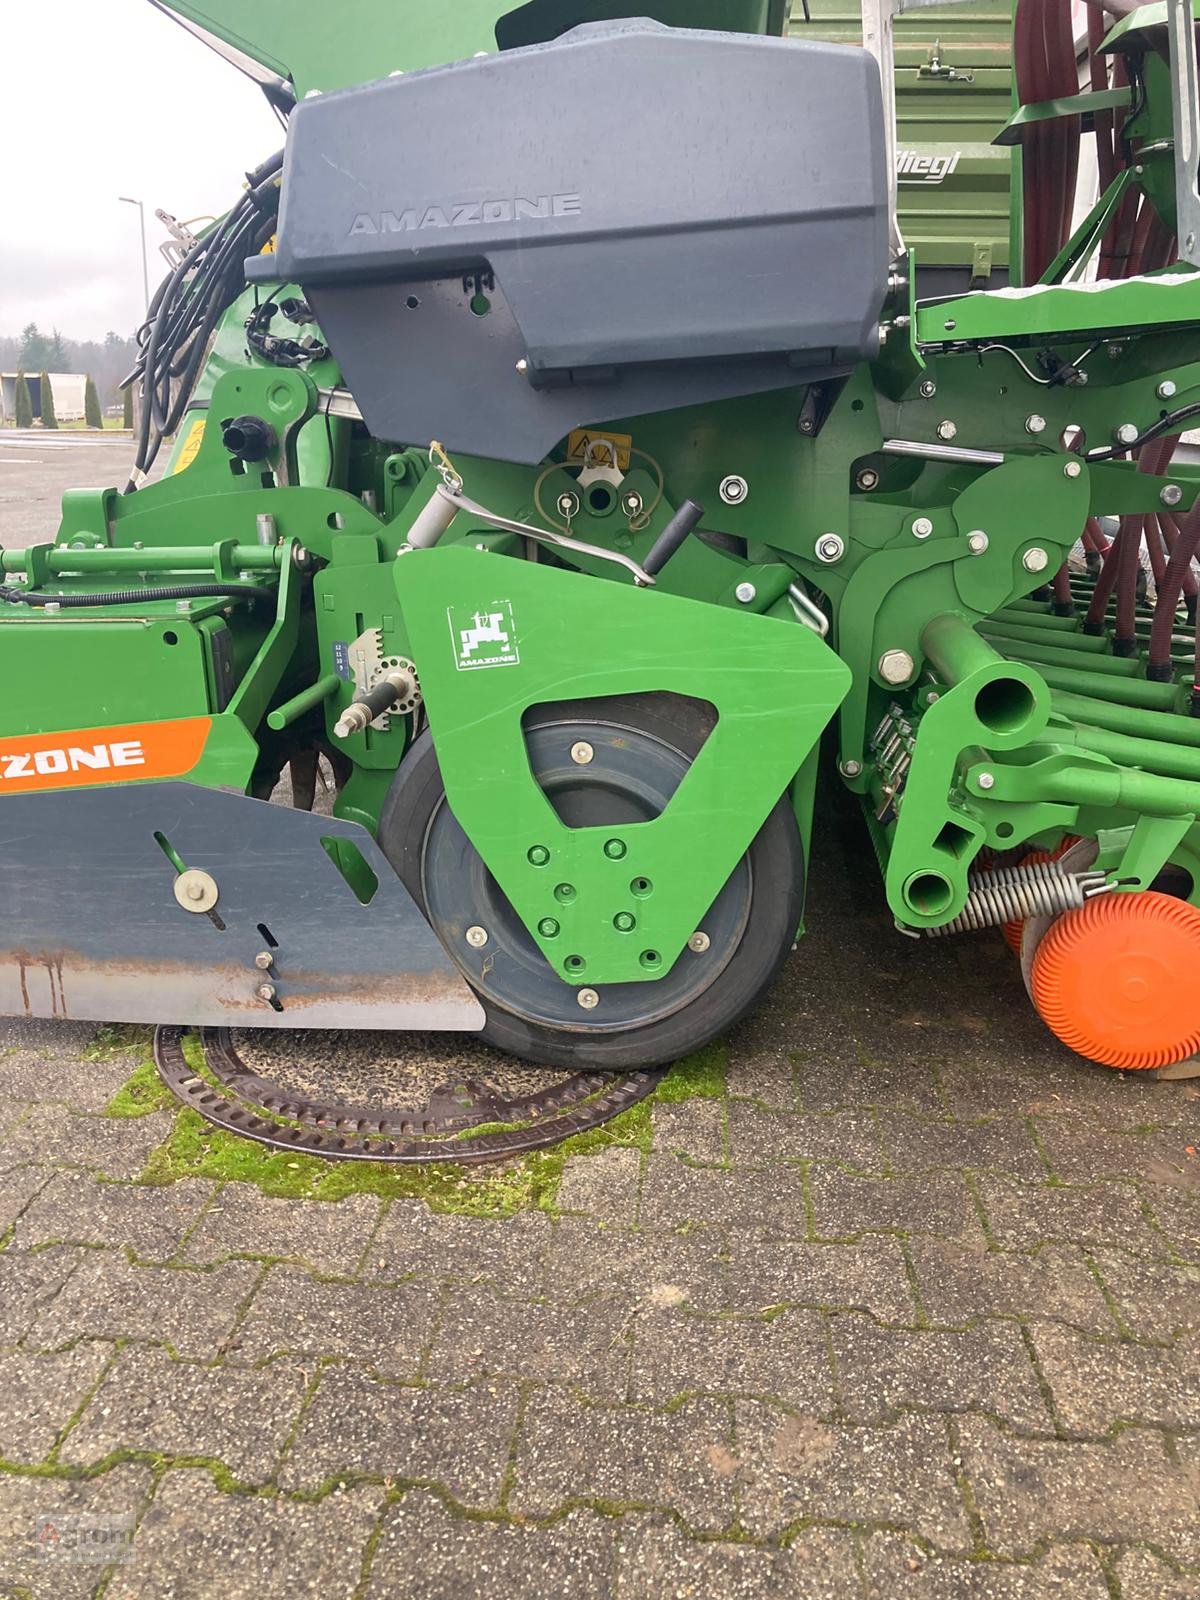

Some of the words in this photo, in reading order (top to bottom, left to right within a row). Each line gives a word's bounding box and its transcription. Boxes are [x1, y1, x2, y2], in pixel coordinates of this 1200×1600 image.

[897, 151, 961, 180] liegl
[348, 193, 581, 236] AMAZONE
[459, 655, 517, 667] AMAZONE
[0, 741, 145, 779] ZONE
